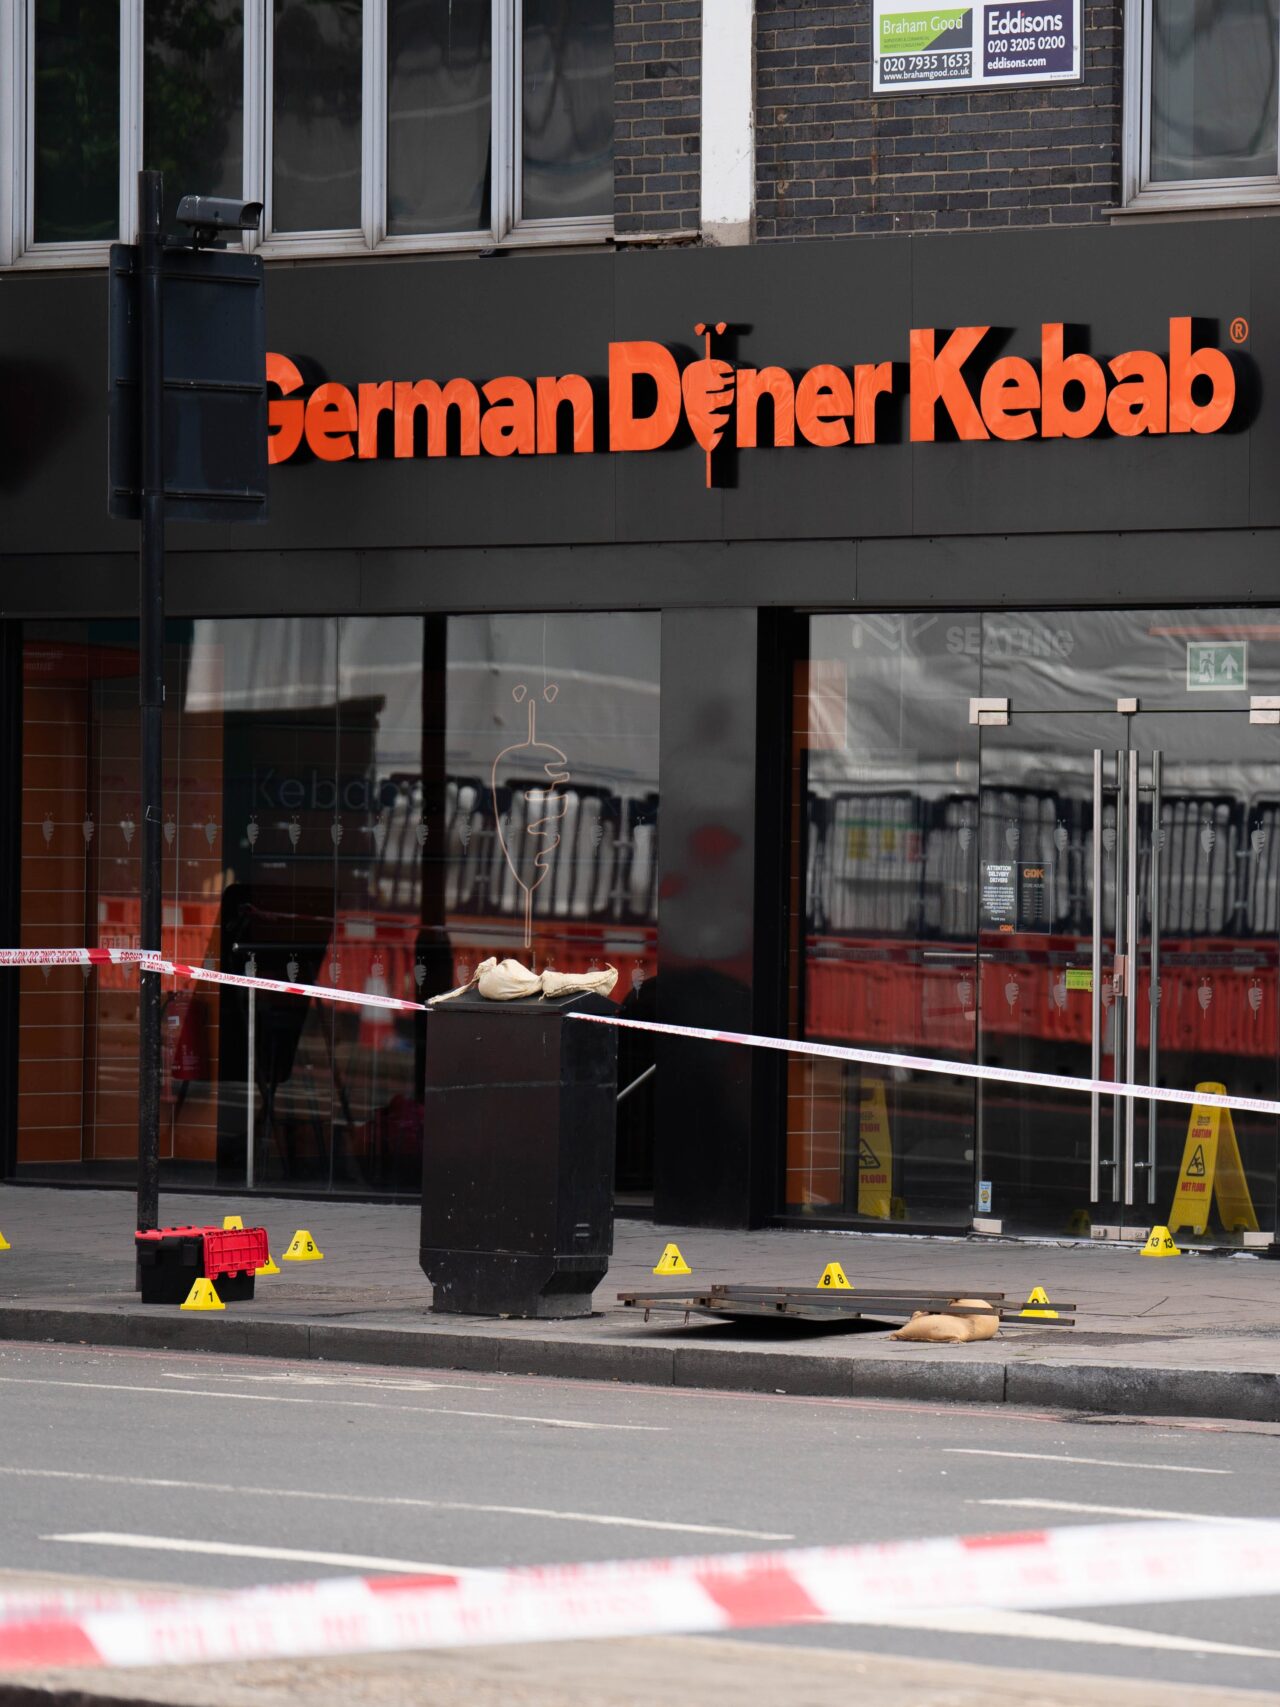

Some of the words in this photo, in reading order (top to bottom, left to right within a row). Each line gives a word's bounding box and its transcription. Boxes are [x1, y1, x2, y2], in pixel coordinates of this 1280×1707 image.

[883, 17, 927, 35] Braham
[931, 15, 963, 32] Good
[988, 11, 1063, 35] Eddisons
[988, 39, 1006, 53] 020
[1010, 38, 1035, 52] 3205
[1038, 36, 1065, 50] 0200
[883, 58, 905, 72] 020
[909, 55, 937, 70] 7935
[942, 53, 970, 68] 1653
[987, 56, 1046, 70] eddisons.com
[884, 67, 970, 81] www.brahamgood.co.uk
[946, 626, 1075, 657] SEATING
[1023, 868, 1045, 879] GDK
[1192, 1128, 1212, 1138] CAUTION
[1181, 1182, 1192, 1191] WET
[1192, 1182, 1206, 1192] FLOOR
[293, 1241, 299, 1251] 5
[306, 1241, 313, 1251] 5
[1150, 1237, 1160, 1247] 13
[1164, 1238, 1174, 1248] 13
[671, 1256, 678, 1266] 7
[823, 1274, 831, 1285] 8
[838, 1273, 844, 1284] 8
[208, 1291, 214, 1302] 1
